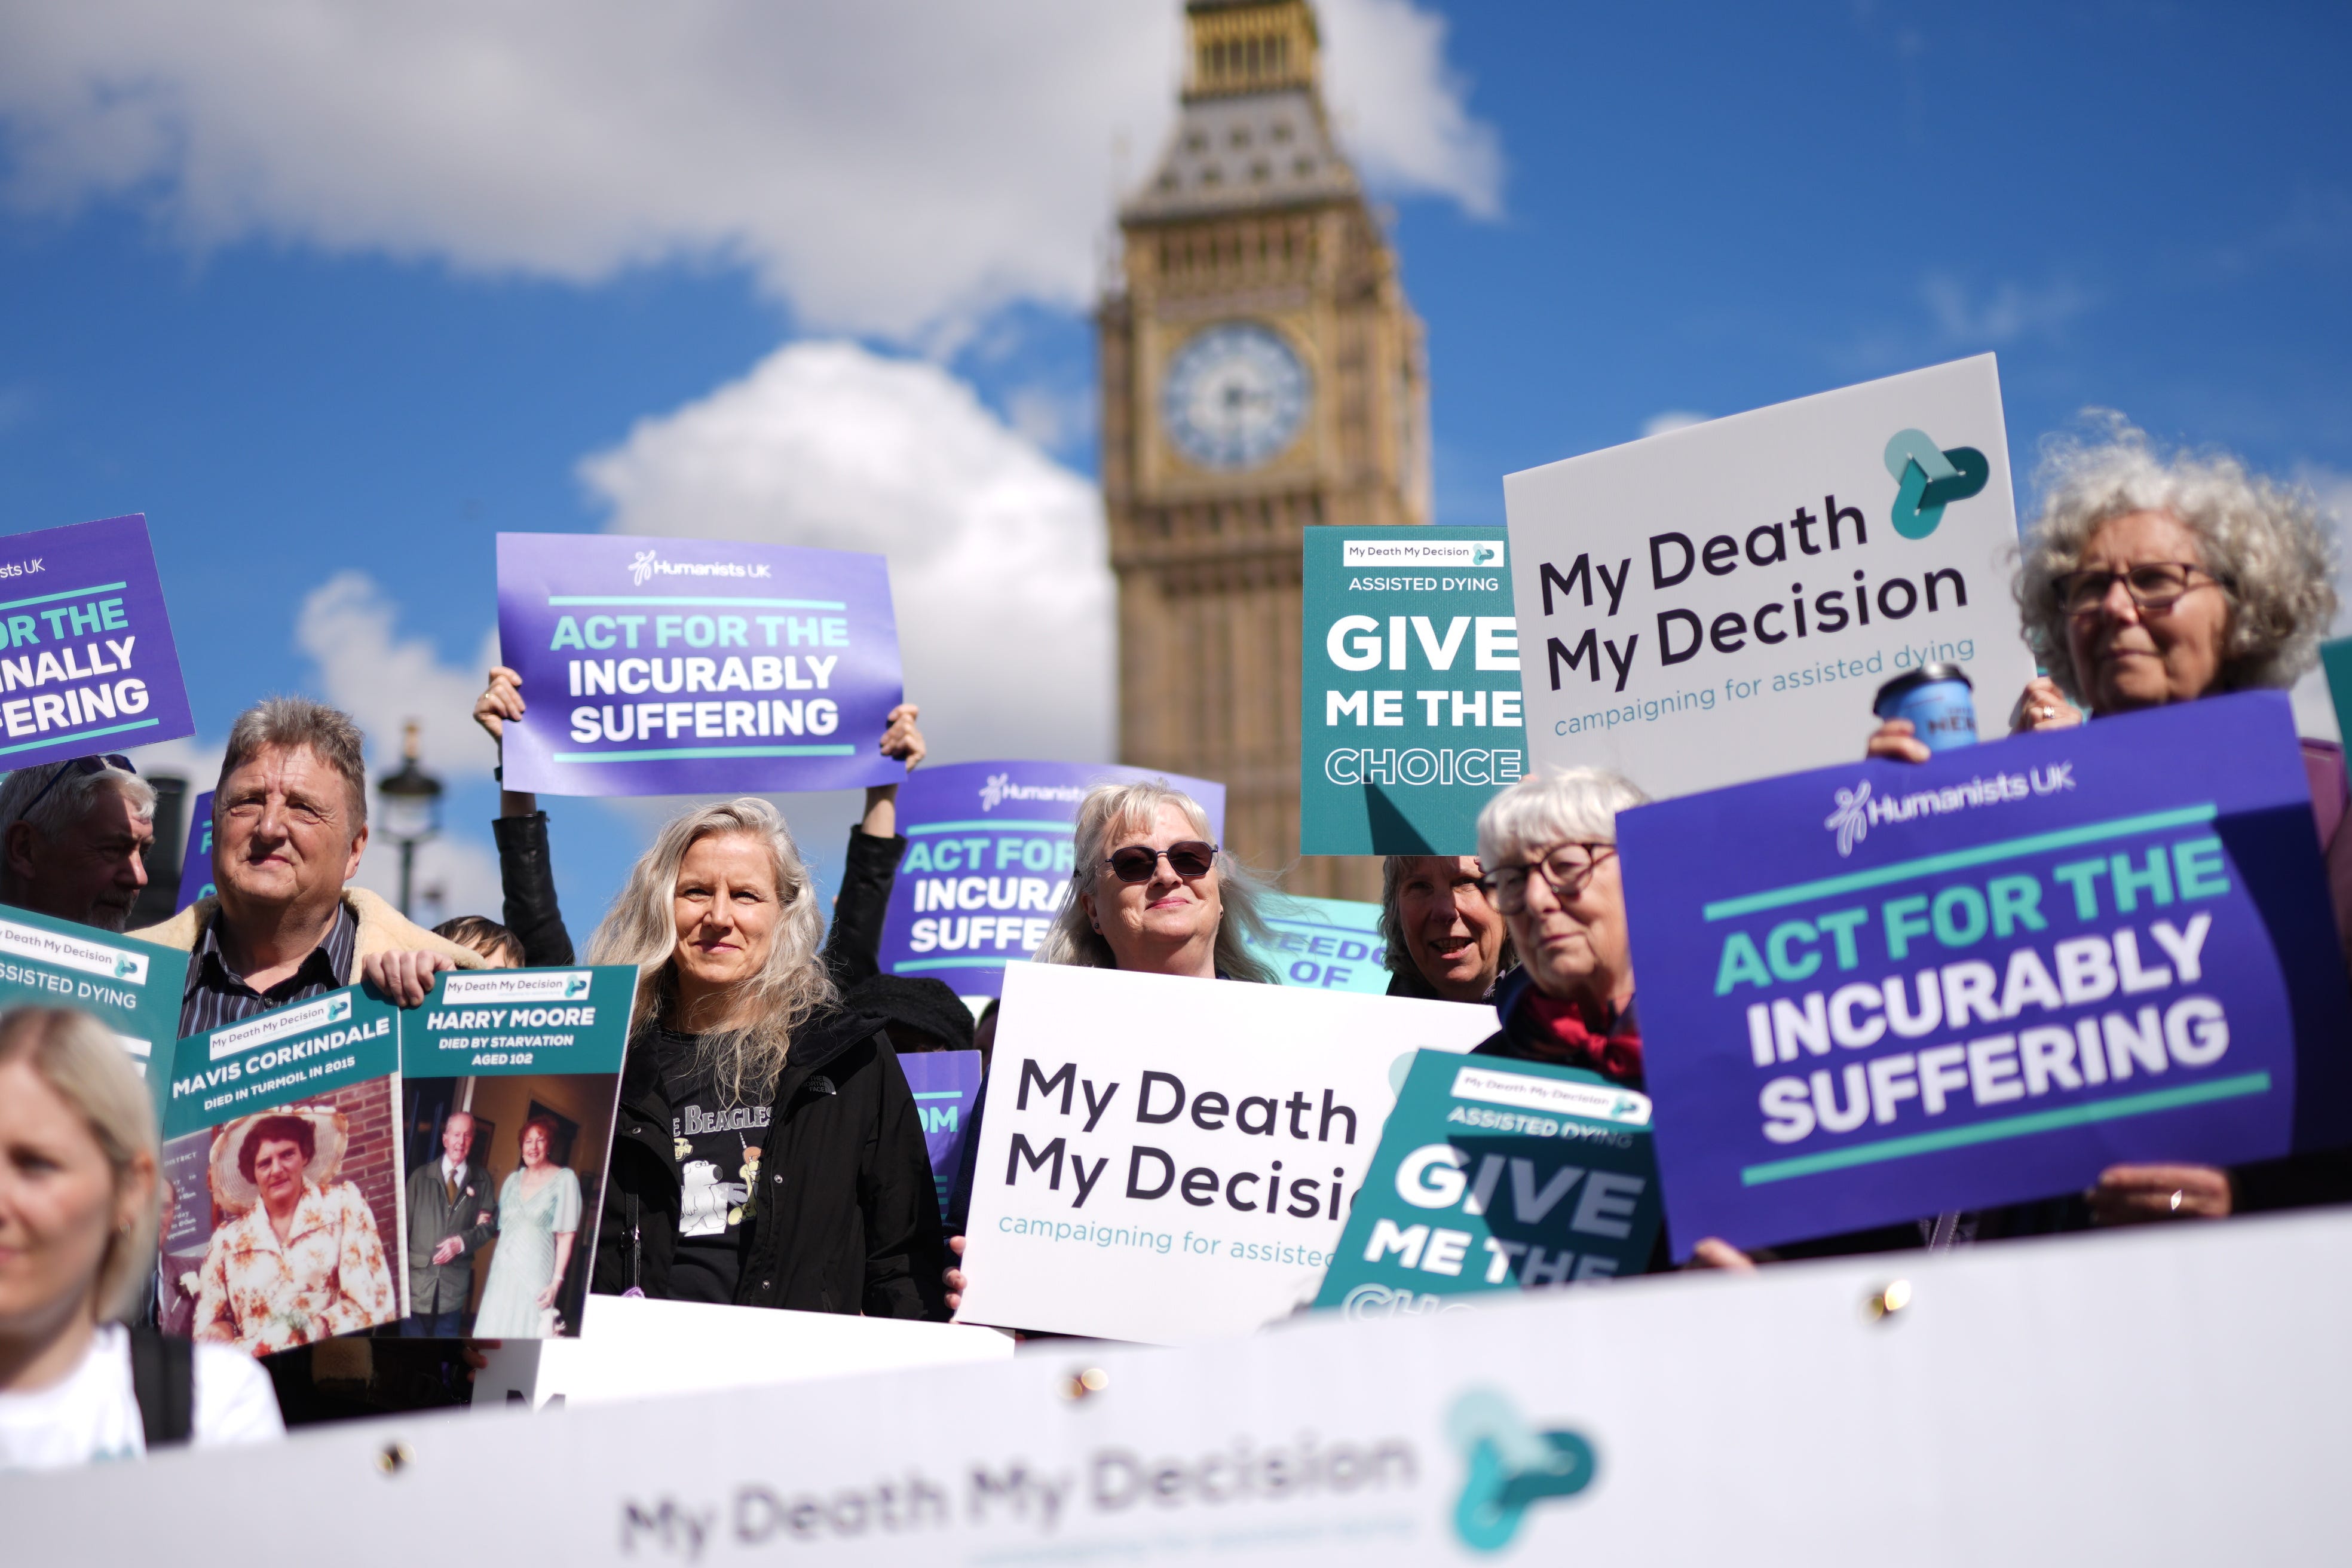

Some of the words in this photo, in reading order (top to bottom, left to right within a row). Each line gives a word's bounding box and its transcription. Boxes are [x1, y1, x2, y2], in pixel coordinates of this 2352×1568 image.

[24, 558, 45, 574] UK
[654, 560, 746, 577] Humanists
[748, 564, 771, 578] UK
[1349, 547, 1365, 558] My
[1368, 546, 1401, 556] Death
[1404, 546, 1420, 558] My
[1423, 546, 1469, 556] Decision
[1539, 552, 1632, 616] My
[1649, 494, 1867, 590] Death
[1349, 577, 1437, 591] ASSISTED
[1443, 577, 1499, 591] DYING
[40, 598, 128, 640] THE
[550, 615, 647, 651] ACT
[656, 615, 749, 649] FOR
[756, 617, 850, 647] THE
[1546, 628, 1639, 693] My
[1657, 567, 1968, 667] Decision
[1326, 614, 1521, 672] GIVE
[0, 636, 135, 693] NALLY
[569, 656, 838, 697] INCURABLY
[0, 679, 149, 737] ERING
[1326, 690, 1404, 726] ME
[1416, 691, 1522, 727] THE
[1554, 685, 1716, 737] campaigning
[1725, 678, 1762, 700] for
[1772, 651, 1883, 693] assisted
[1894, 638, 1974, 670] dying
[570, 699, 838, 743] SUFFERING
[1325, 748, 1522, 786] CHOICE
[1868, 775, 2030, 825] Humanists
[2031, 762, 2076, 793] UK
[902, 838, 991, 874] ACT
[996, 838, 1076, 872] FOR
[1714, 907, 1869, 996] ACT
[1882, 874, 2048, 960] FOR
[2054, 837, 2231, 921] THE
[5, 930, 41, 947] Death
[44, 939, 62, 953] My
[63, 944, 112, 964] Decision
[448, 983, 461, 993] My
[464, 981, 497, 991] Death
[500, 981, 514, 991] My
[517, 979, 563, 990] Decision
[1289, 960, 1352, 988] OF
[1747, 912, 2213, 1067] INCURABLY
[78, 983, 136, 1009] DYING
[212, 1038, 226, 1048] My
[229, 1027, 261, 1043] Death
[263, 1022, 277, 1033] My
[280, 1007, 324, 1027] Decision
[427, 1010, 507, 1030] HARRY
[509, 1007, 596, 1028] MOORE
[173, 1062, 241, 1098] MAVIS
[245, 1017, 390, 1073] CORKINDALE
[439, 1037, 471, 1050] DIED
[471, 1037, 489, 1049] BY
[490, 1034, 574, 1048] STARVATION
[471, 1054, 509, 1065] AGED
[509, 1054, 533, 1065] 102
[204, 1094, 234, 1110] DIED
[235, 1088, 249, 1101] IN
[251, 1071, 307, 1095] TURMOIL
[309, 1064, 323, 1077] IN
[325, 1056, 355, 1073] 2015
[1465, 1077, 1482, 1087] My
[1486, 1080, 1526, 1093] Death
[1530, 1086, 1548, 1098] My
[1552, 1089, 1609, 1105] Decision
[1759, 997, 2230, 1144] SUFFERING
[1016, 1058, 1120, 1132] My
[1135, 1070, 1357, 1145] Death
[1446, 1105, 1558, 1137] ASSISTED
[1560, 1121, 1633, 1149] DYING
[1005, 1132, 1109, 1208] My
[1125, 1144, 1362, 1221] Decisi
[1395, 1143, 1646, 1239] GIVE
[999, 1215, 1172, 1254] campaigning
[1183, 1231, 1221, 1255] for
[1363, 1218, 1473, 1276] ME
[621, 1495, 713, 1564] My
[733, 1471, 949, 1542] Death
[966, 1462, 1071, 1533] My
[1091, 1431, 1419, 1511] Decision
